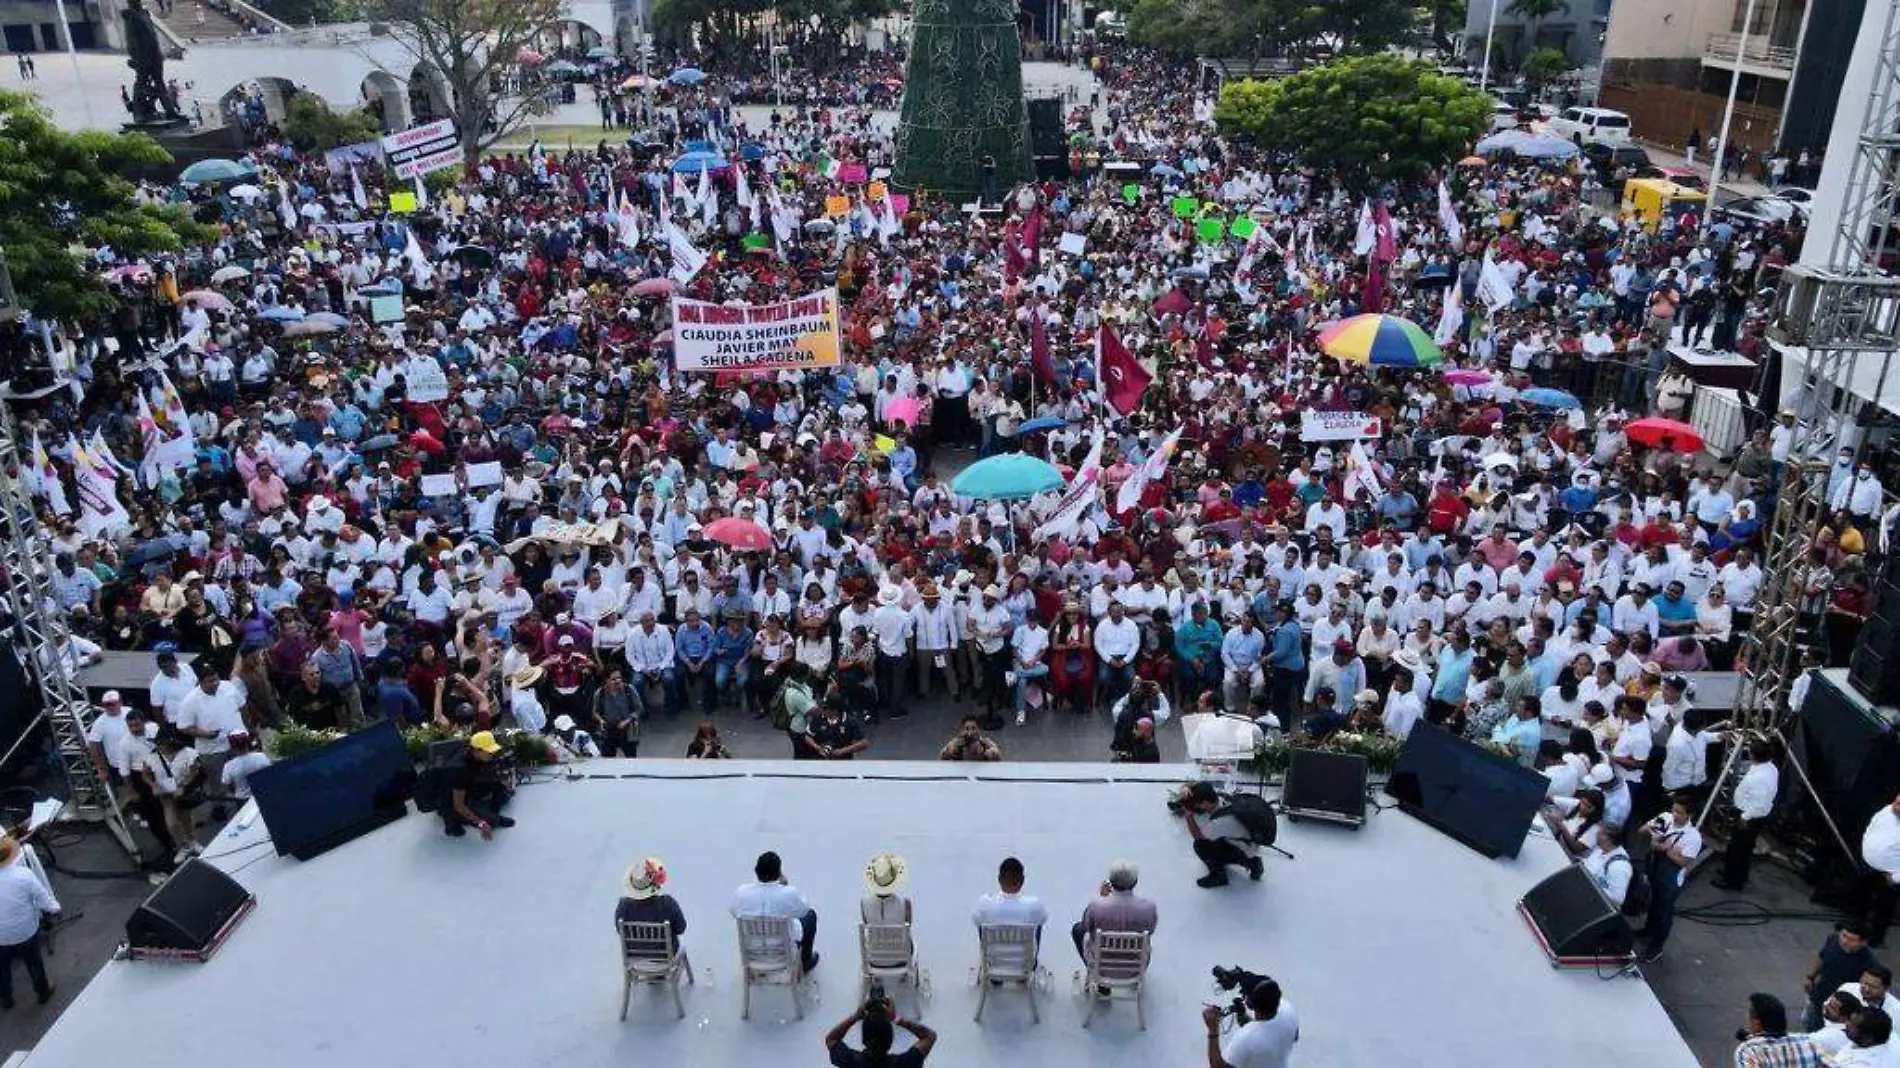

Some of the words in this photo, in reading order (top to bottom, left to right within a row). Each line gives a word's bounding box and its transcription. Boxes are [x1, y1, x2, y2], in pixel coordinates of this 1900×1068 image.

[746, 320, 831, 340] SHEINBAUM
[716, 341, 765, 354] JAVIER
[769, 336, 798, 351] MAY
[701, 354, 752, 366] SHEILA
